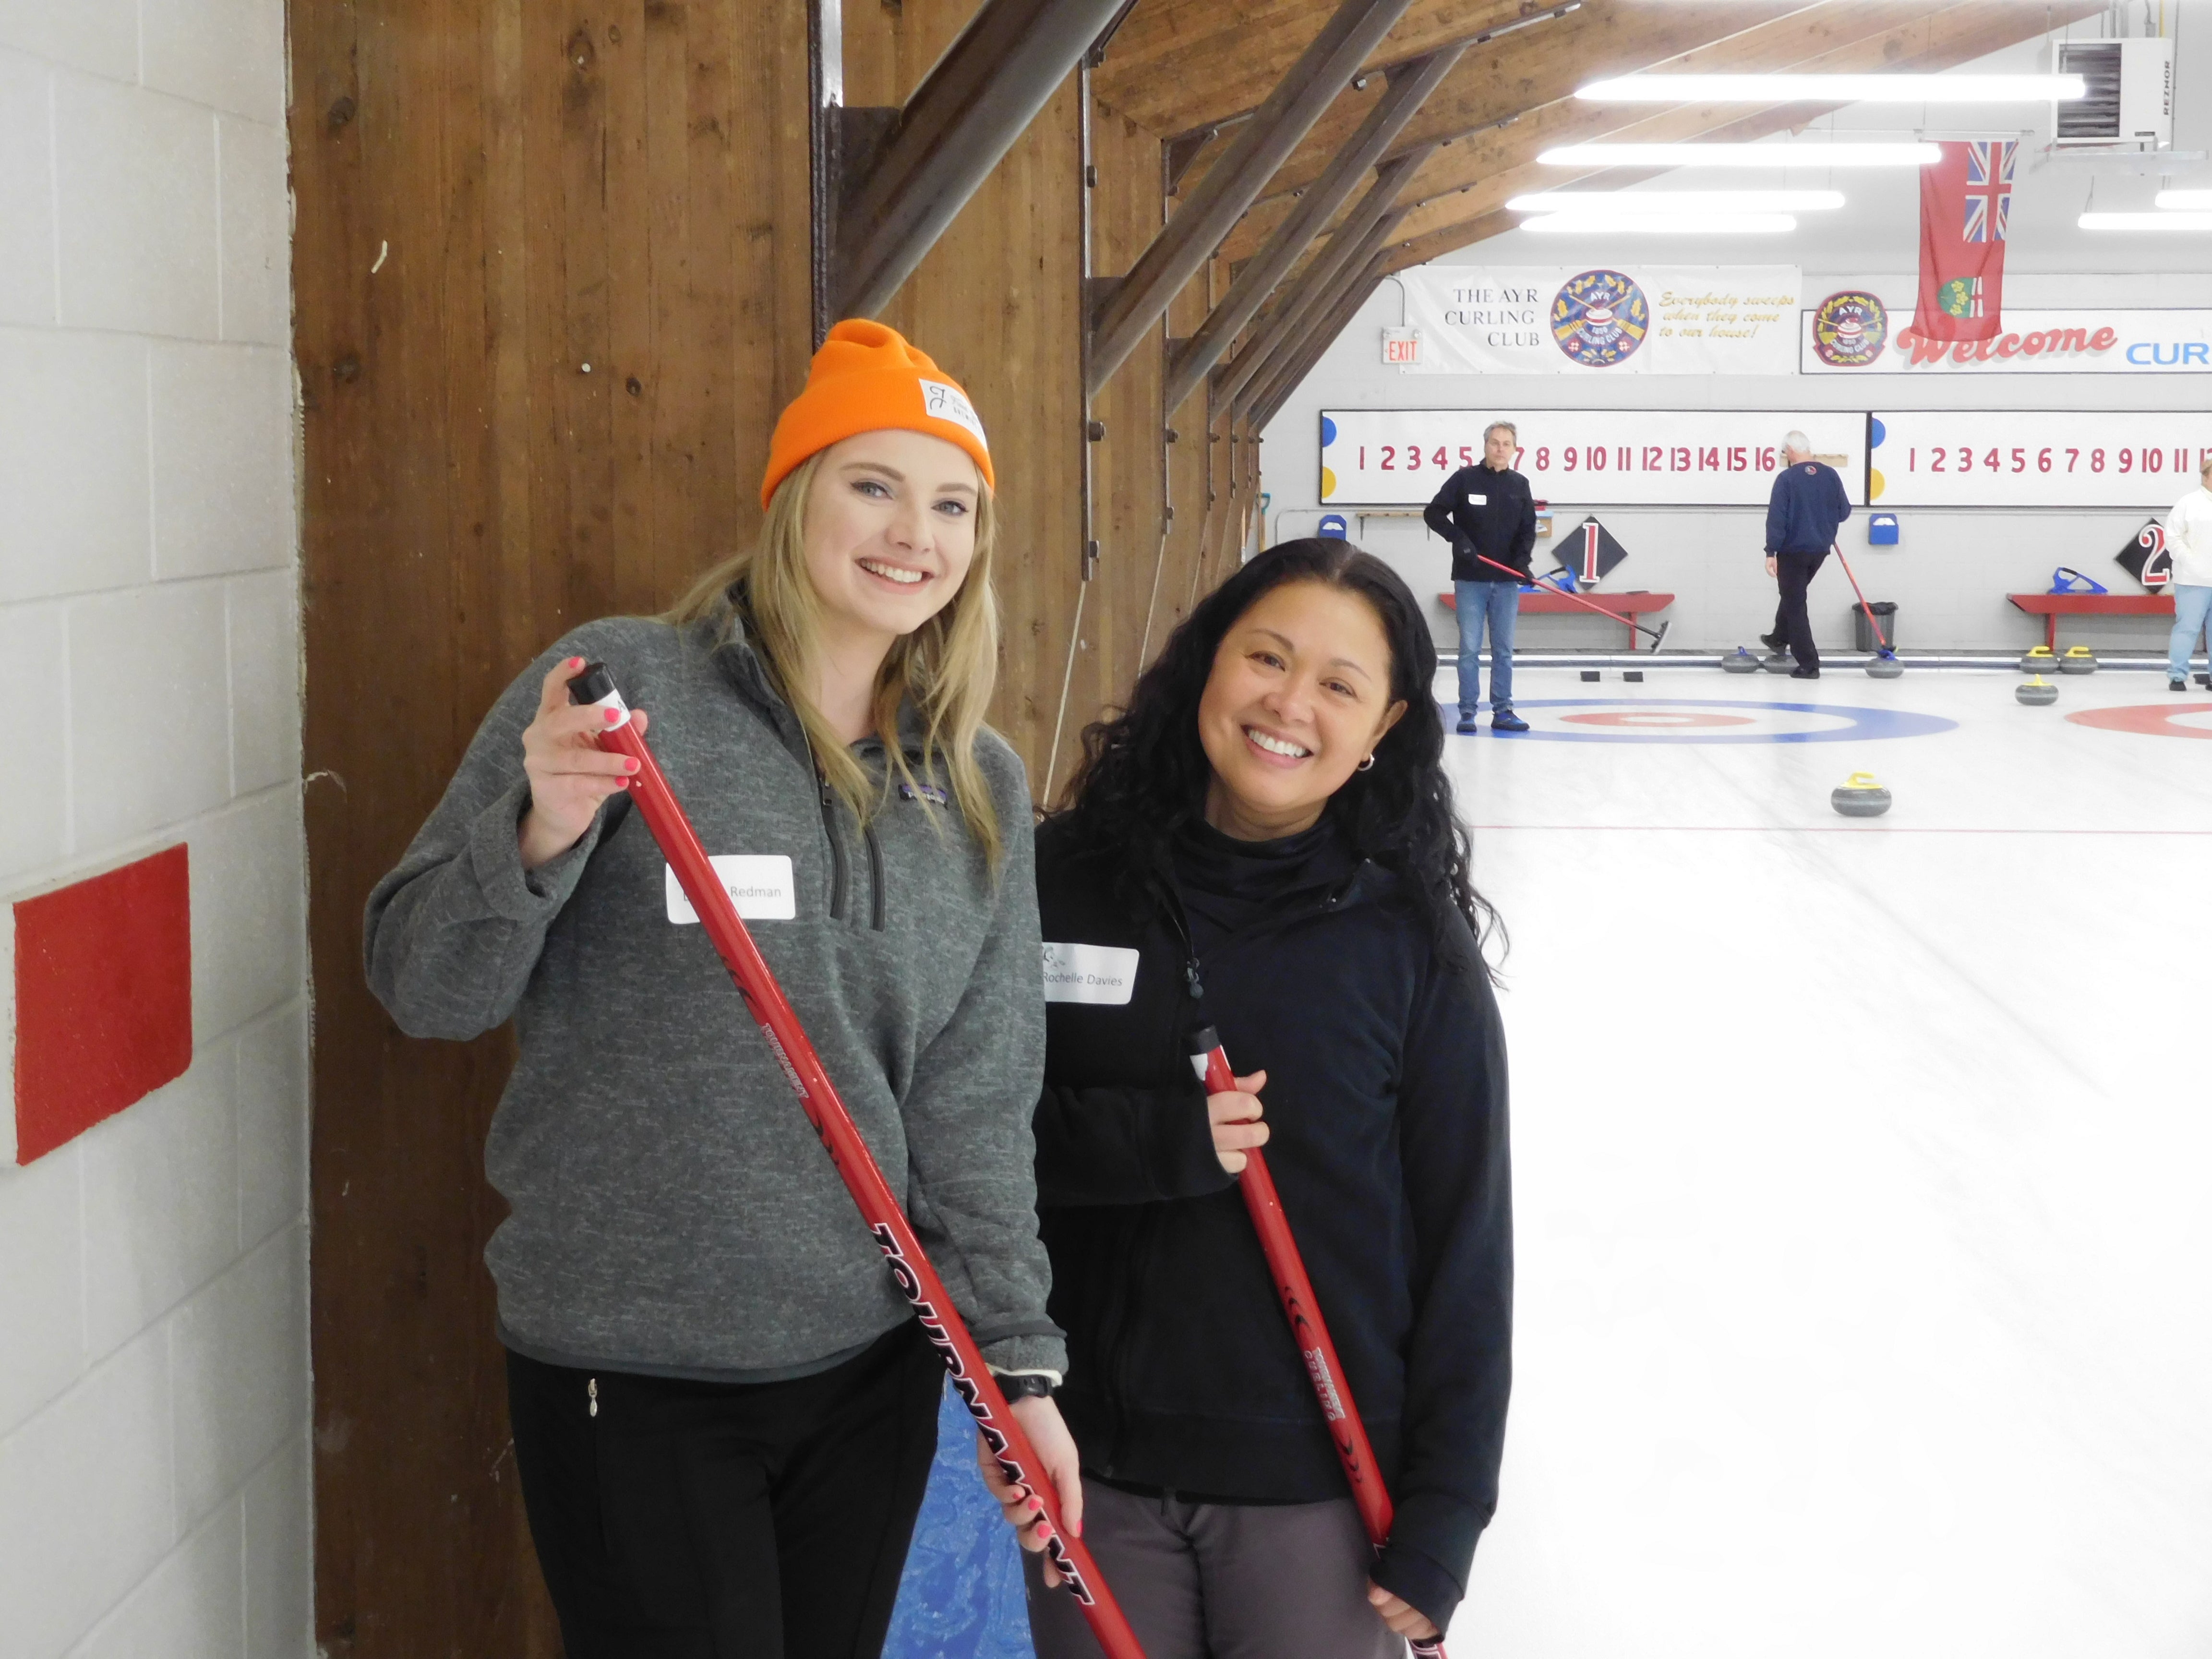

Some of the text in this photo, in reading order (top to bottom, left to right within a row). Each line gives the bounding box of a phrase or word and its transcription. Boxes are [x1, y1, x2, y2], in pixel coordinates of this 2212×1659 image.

[1453, 289, 1539, 303] THE AYR
[1590, 291, 1611, 301] AYR
[1659, 291, 1795, 308] Everybody sweeps
[1444, 311, 1534, 325] CURLING
[1663, 308, 1700, 321] when
[1707, 309, 1737, 324] they
[1839, 306, 1863, 315] AYR
[1488, 332, 1539, 346] CLUB
[1606, 327, 1623, 343] CLUB
[1659, 327, 1673, 337] to
[1709, 324, 1760, 338] house!
[1389, 341, 1417, 361] EXIT
[1897, 326, 2210, 365] Welcome CUR
[1359, 445, 1472, 470] 1 2 3 4 5
[1514, 446, 1775, 471] 7 8 9 10 11 12 13 14 15 16
[1910, 447, 2212, 473] 1 2 3 4 5 6 7 8 9 10 11 1
[1579, 523, 1600, 583] 1
[2139, 524, 2170, 586] 2
[731, 886, 781, 897] Redman
[1043, 971, 1123, 986] Rochelle Davies
[871, 1222, 1095, 1605] TOURNAMNT
